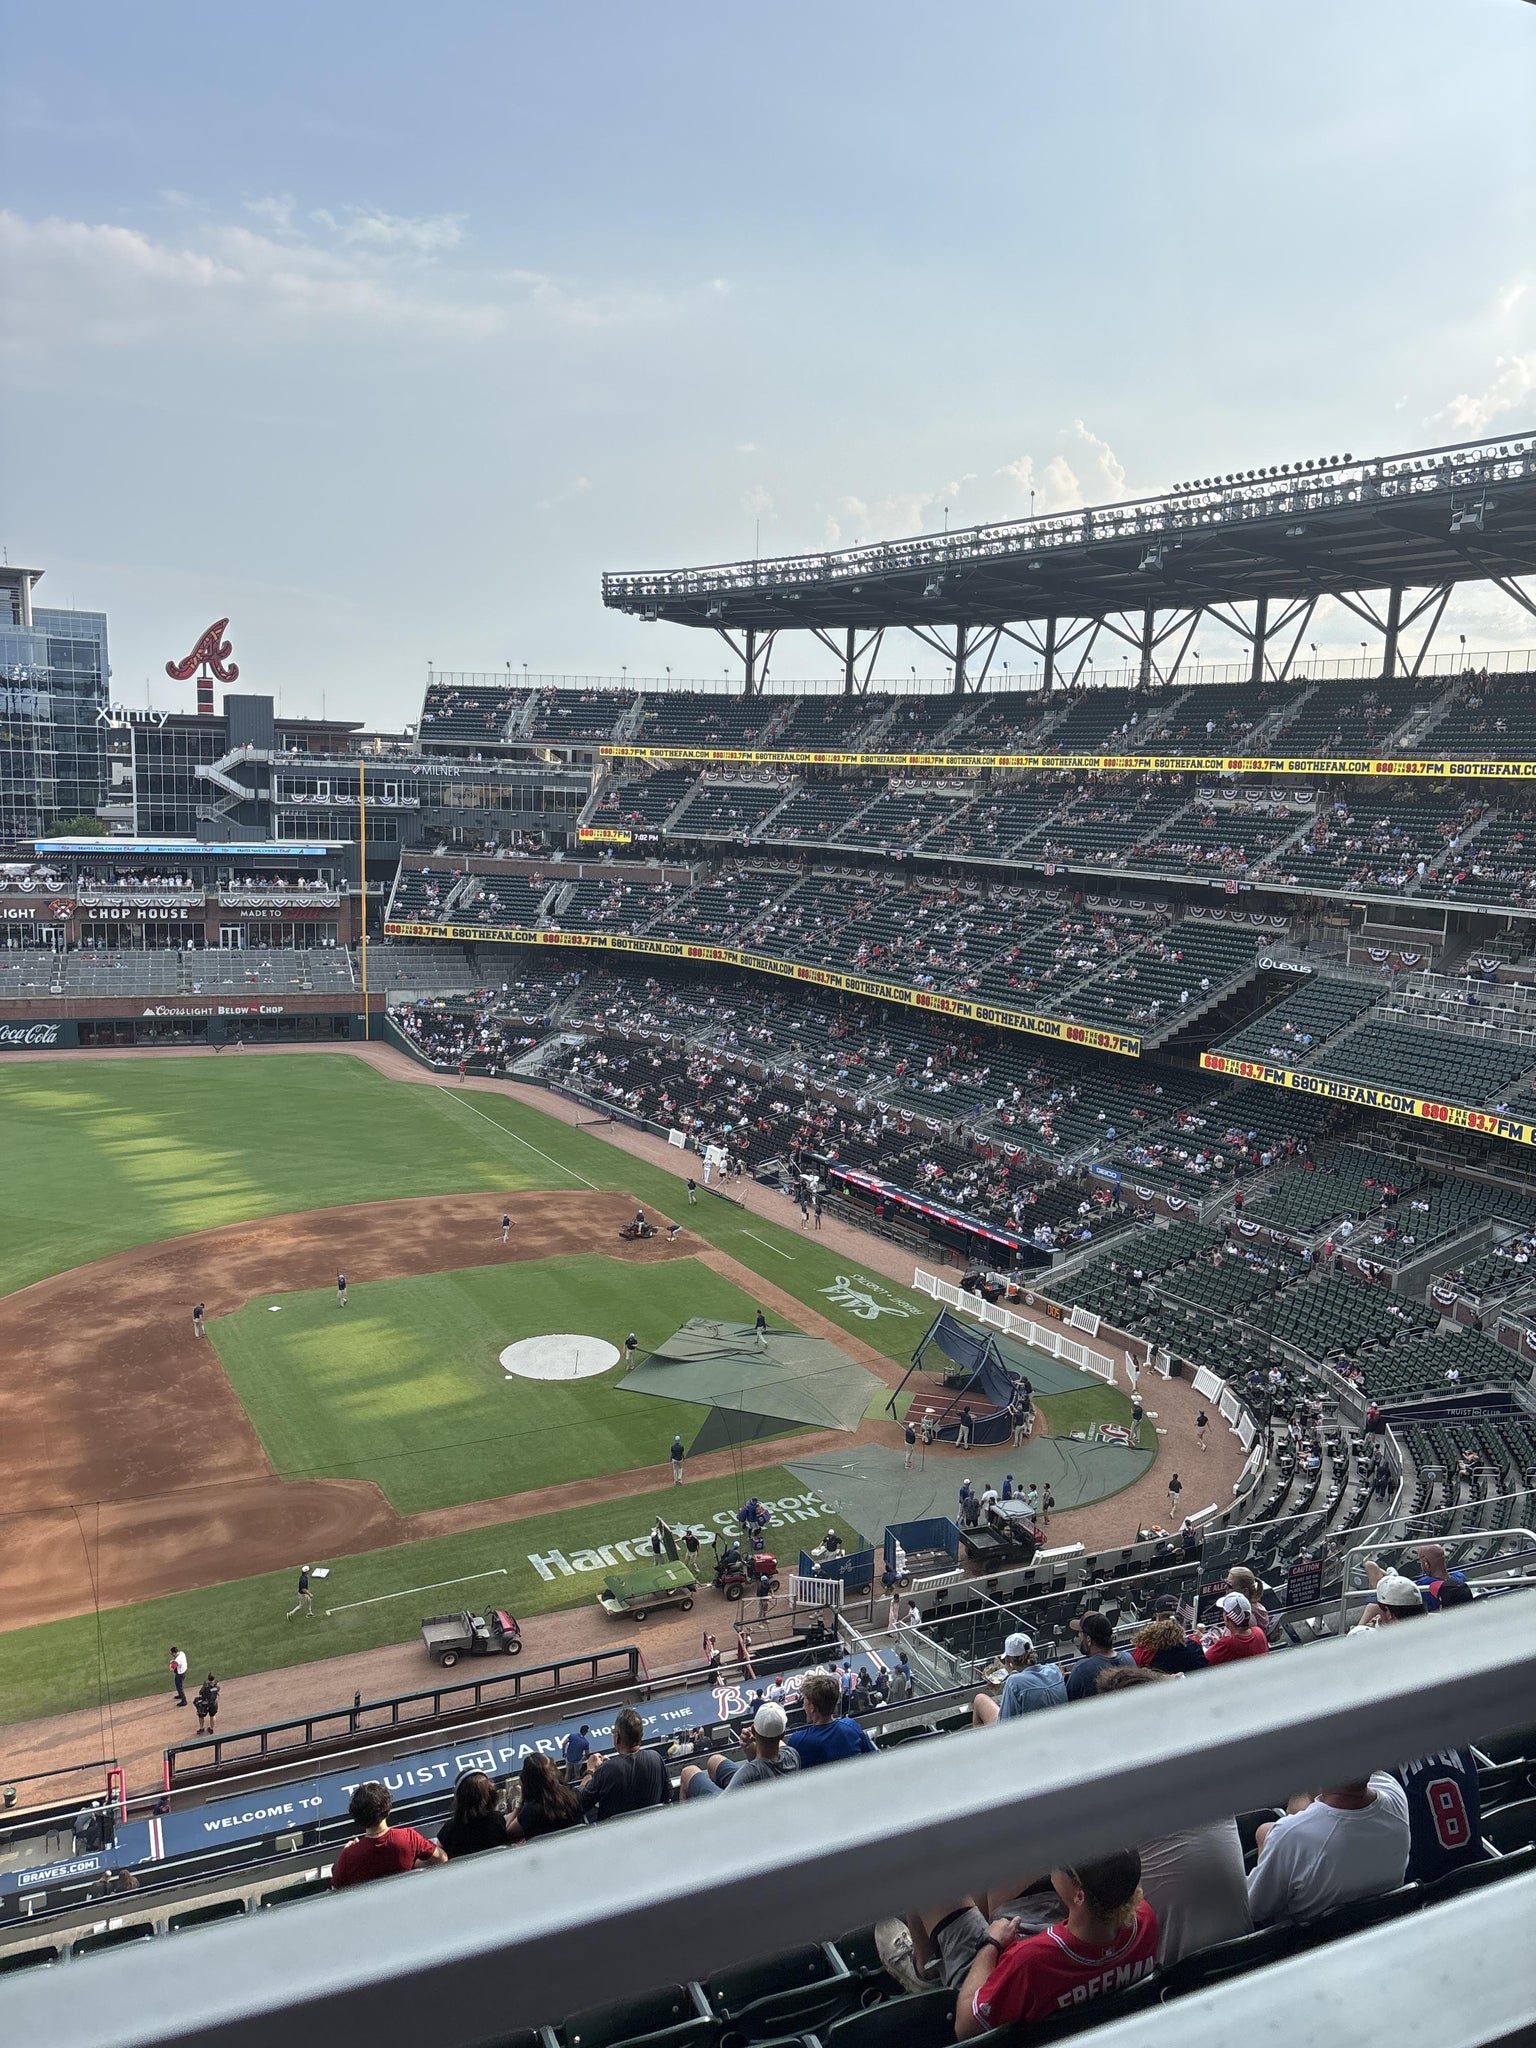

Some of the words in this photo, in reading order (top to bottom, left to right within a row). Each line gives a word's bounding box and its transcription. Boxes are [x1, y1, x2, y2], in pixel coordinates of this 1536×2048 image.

[96, 702, 169, 728] xfinity
[650, 750, 710, 758] 680THEFAN.COM
[755, 752, 810, 761] 680THEFAN.COM
[860, 756, 907, 764] 680THEFAN.COM
[946, 757, 996, 765] 680THEFAN.COM
[1042, 758, 1100, 766] 680THEFAN.COM
[1154, 759, 1224, 769] 680THEFAN.COM
[1288, 761, 1370, 772] 680THEFAN.COM
[1376, 762, 1393, 772] 680
[422, 766, 461, 776] MILNER
[1225, 880, 1238, 894] 21
[0, 908, 36, 921] IGHT
[88, 908, 131, 919] CHOP
[138, 908, 189, 919] HOUSE
[1273, 962, 1312, 973] LEXUS
[385, 924, 401, 934] 680
[452, 929, 538, 942] 680THEFAN.COM
[543, 934, 560, 943] 680
[611, 938, 683, 955] 680THEFAN.COM
[741, 955, 794, 975] 680THEFAN.COM
[845, 979, 912, 1003] 680THEFAN.COM
[976, 1007, 1060, 1037] 680THEFAN.COM
[218, 1006, 248, 1015] BELOW
[260, 1005, 284, 1014] CHOP
[1204, 1055, 1225, 1071] 680
[1291, 1075, 1415, 1114] 680THEFAN.COM
[1422, 1103, 1449, 1121] 680
[1292, 1562, 1320, 1574] CAUTION
[1202, 1585, 1213, 1594] BE
[1213, 1582, 1228, 1592] ALE
[642, 1716, 657, 1726] OF
[204, 1803, 294, 1831] WELCOME
[299, 1796, 323, 1808] TO
[1426, 1777, 1472, 1850] 8
[22, 1860, 94, 1883] BRAVES.COM
